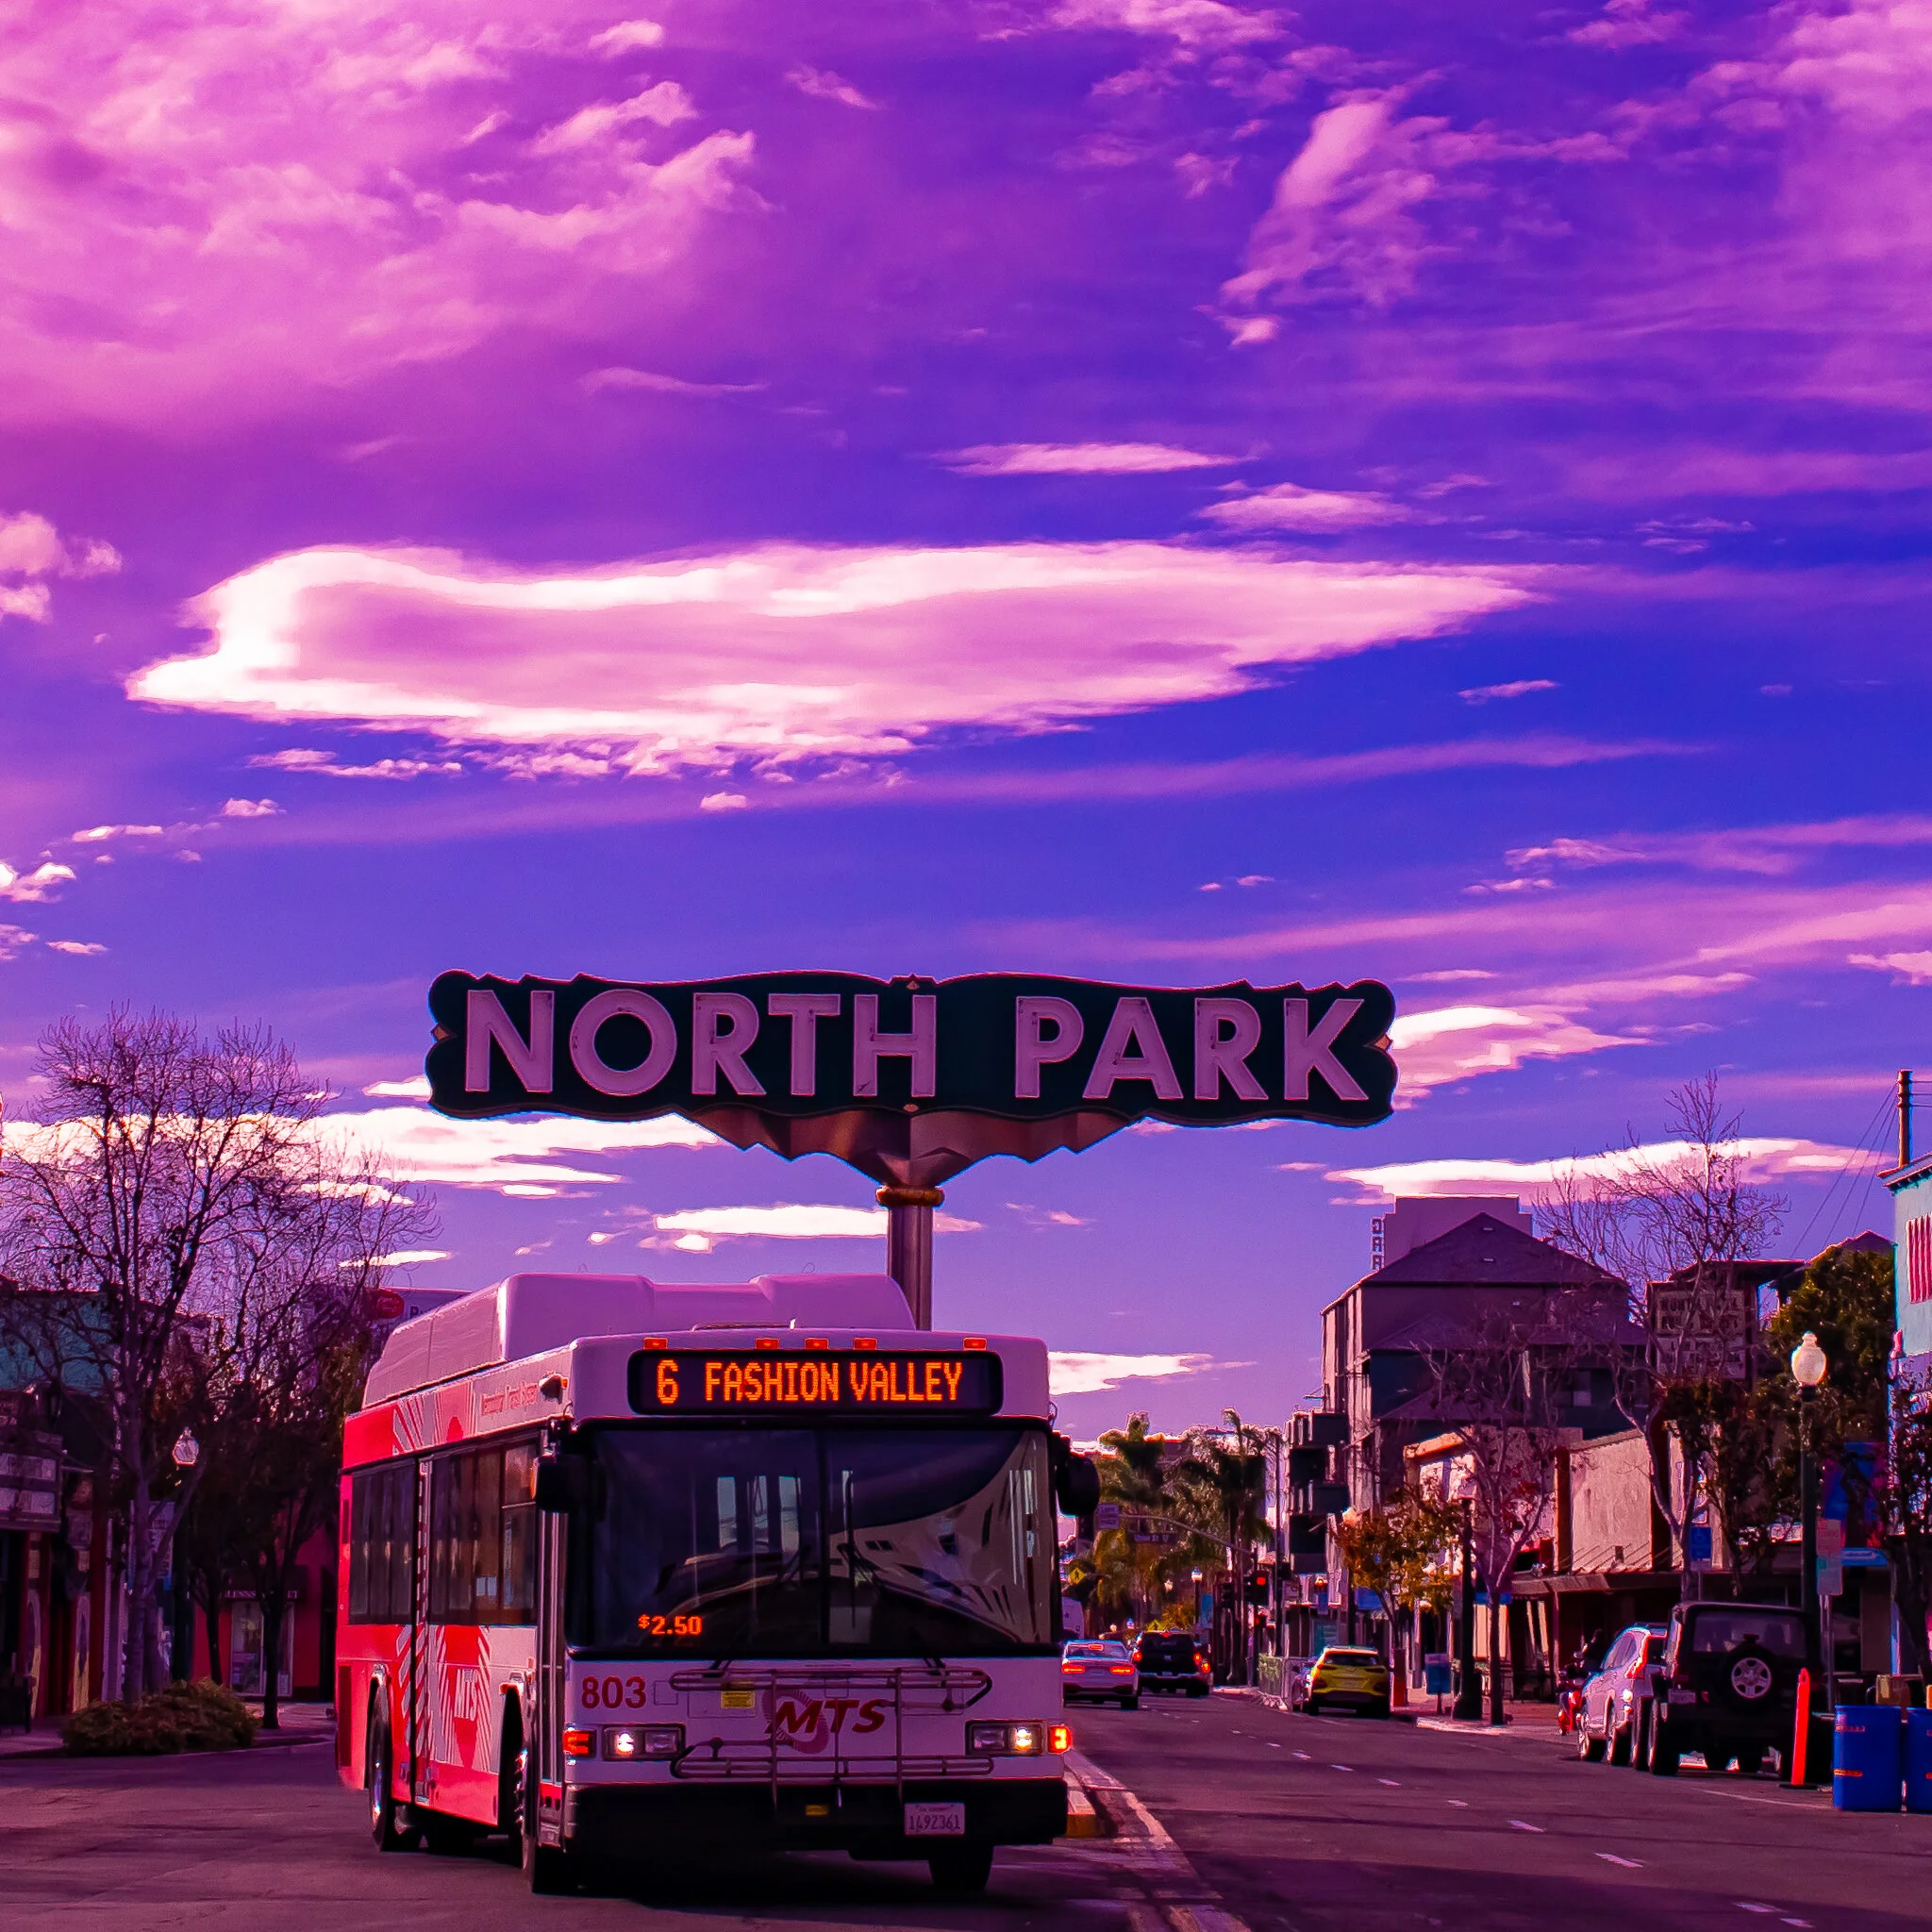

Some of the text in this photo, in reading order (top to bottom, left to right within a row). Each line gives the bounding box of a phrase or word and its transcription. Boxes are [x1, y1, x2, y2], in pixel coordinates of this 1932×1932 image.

[465, 989, 1370, 1101] NORTH PARK
[657, 1359, 963, 1404] 6 FASHION VALLEY
[638, 1614, 703, 1635] $2.50
[581, 1675, 647, 1708] 803
[764, 1699, 887, 1734] MTS
